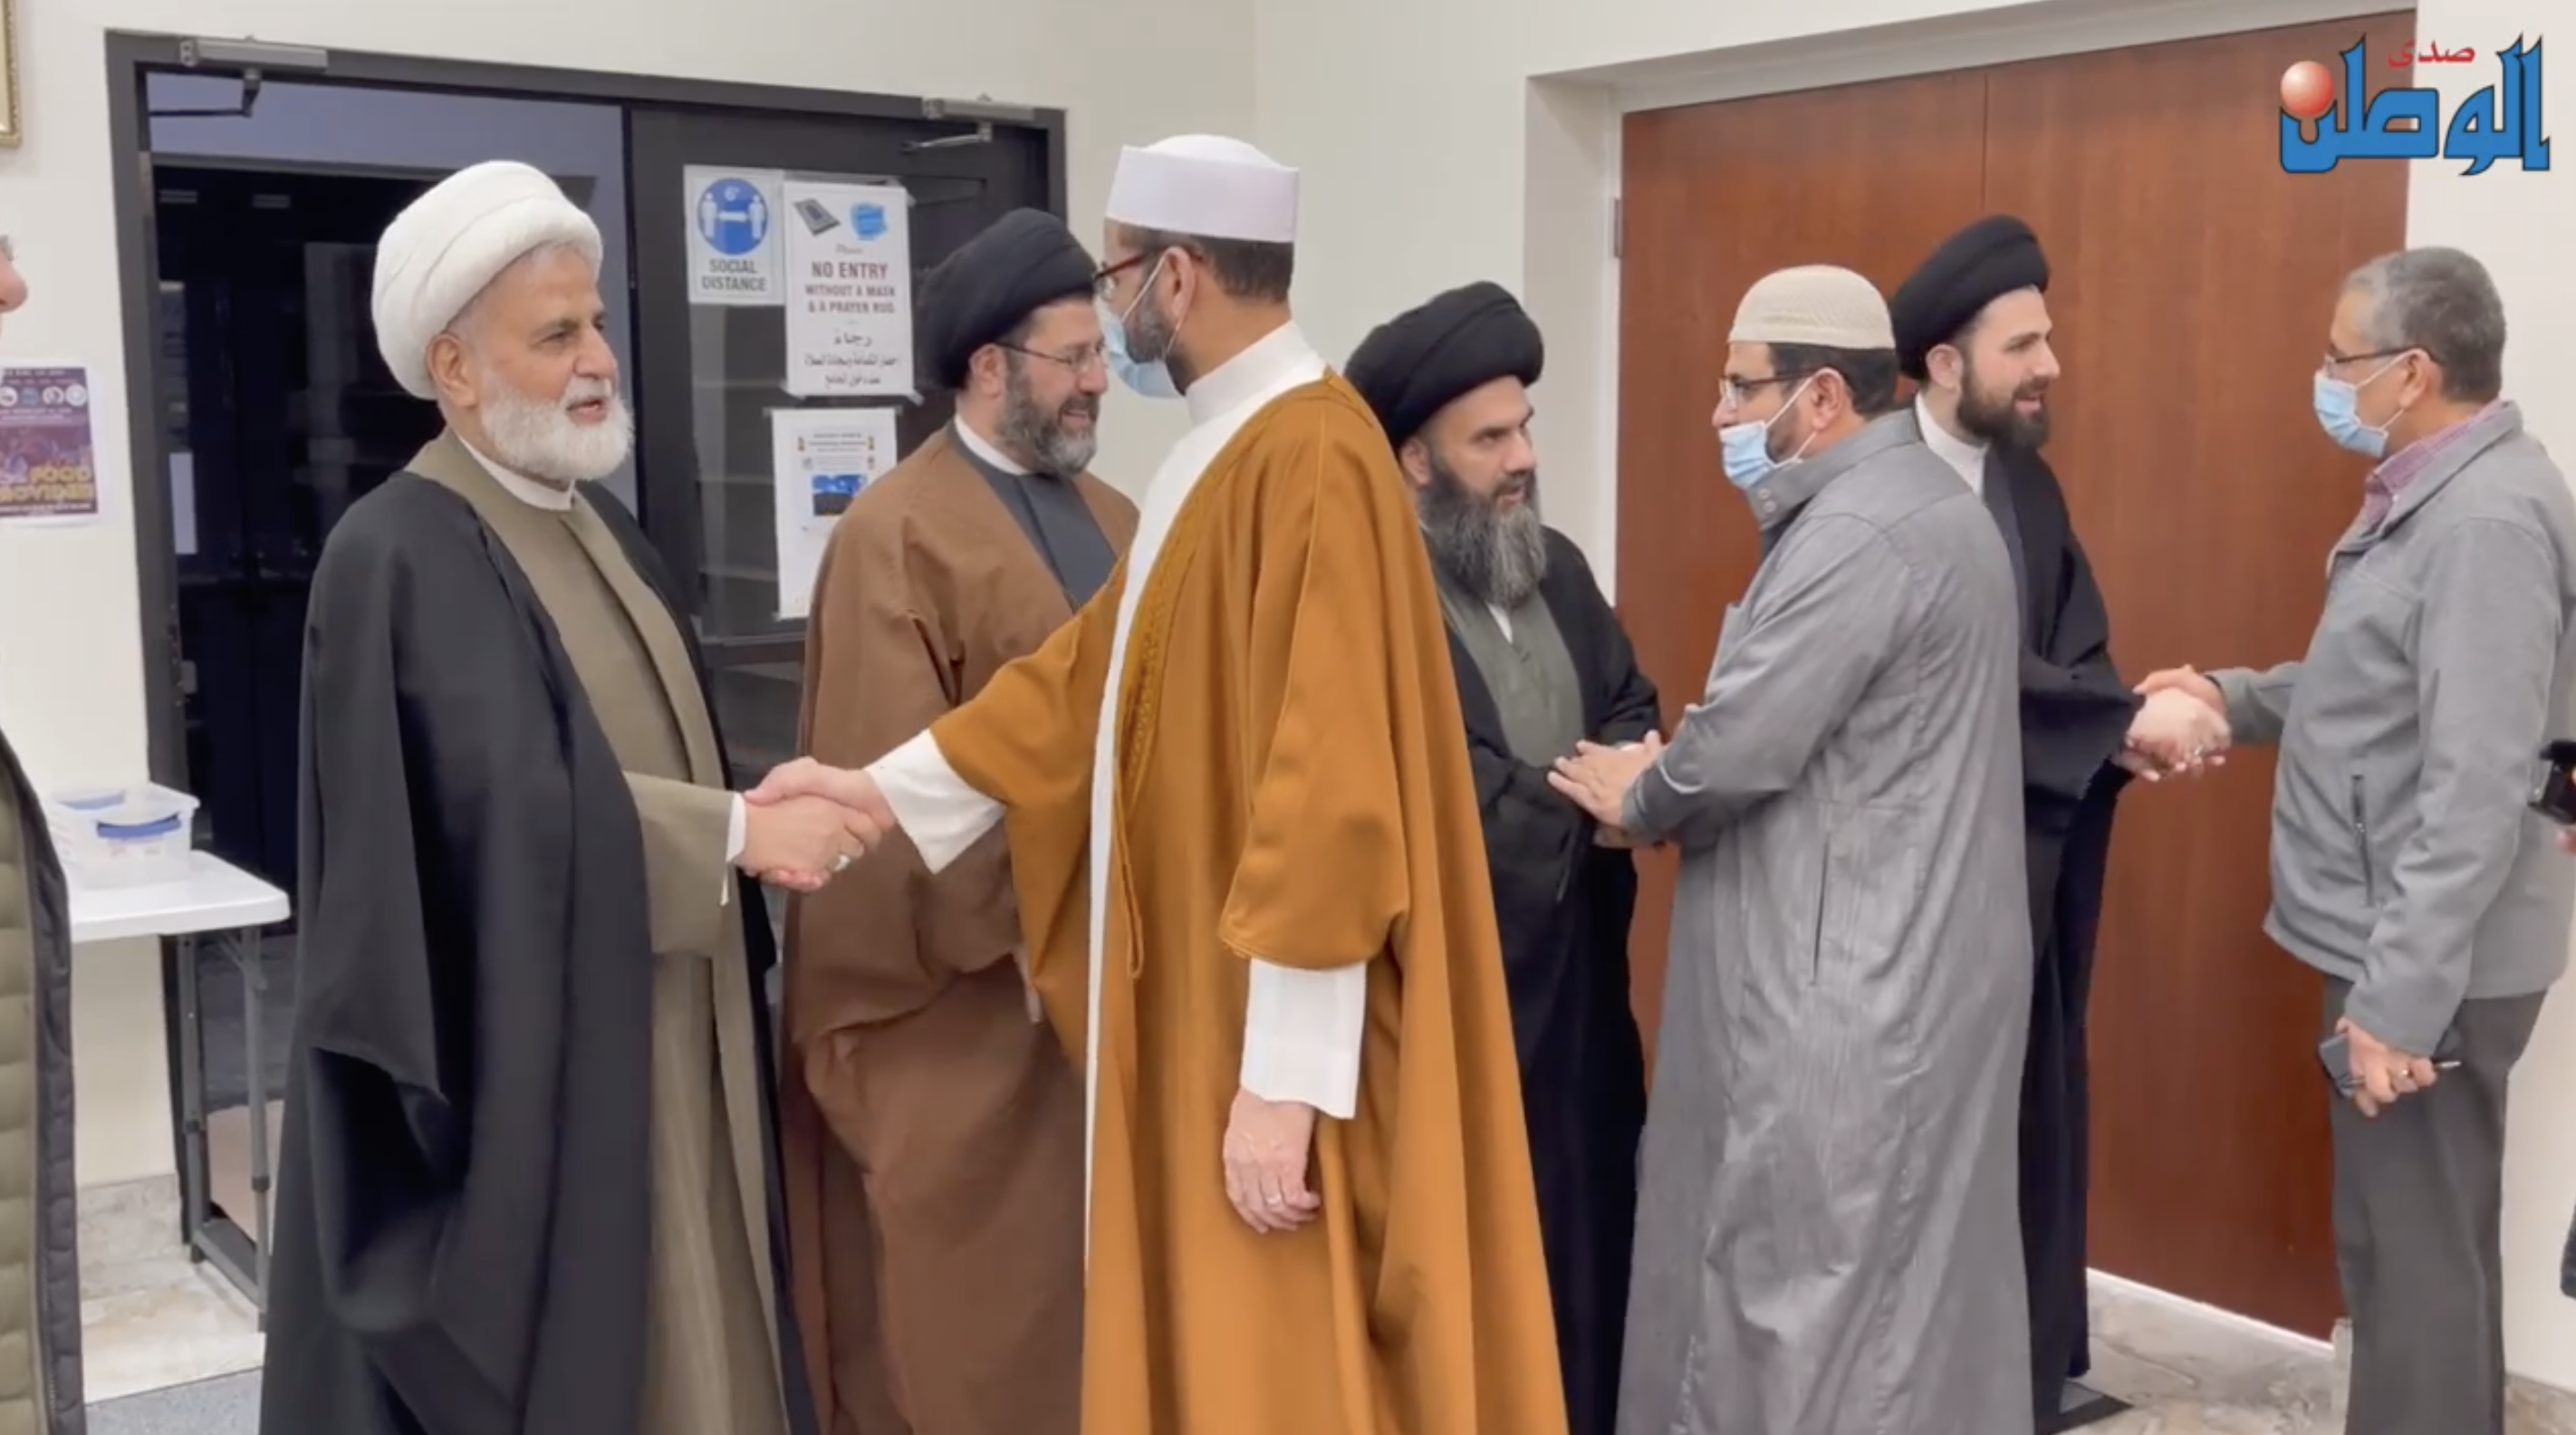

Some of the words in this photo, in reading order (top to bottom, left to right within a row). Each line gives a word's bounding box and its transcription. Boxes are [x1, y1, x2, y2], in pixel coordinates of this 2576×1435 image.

[708, 258, 758, 274] SOCIAL
[811, 261, 834, 278] NO
[838, 261, 889, 280] ENTRY
[701, 275, 767, 292] DISTANCE
[804, 284, 852, 296] WITHOUT
[856, 285, 863, 296] A
[866, 285, 896, 297] MASK
[808, 301, 816, 313] &
[819, 301, 826, 313] A
[829, 301, 870, 313] PRAYER
[872, 302, 896, 313] RUG
